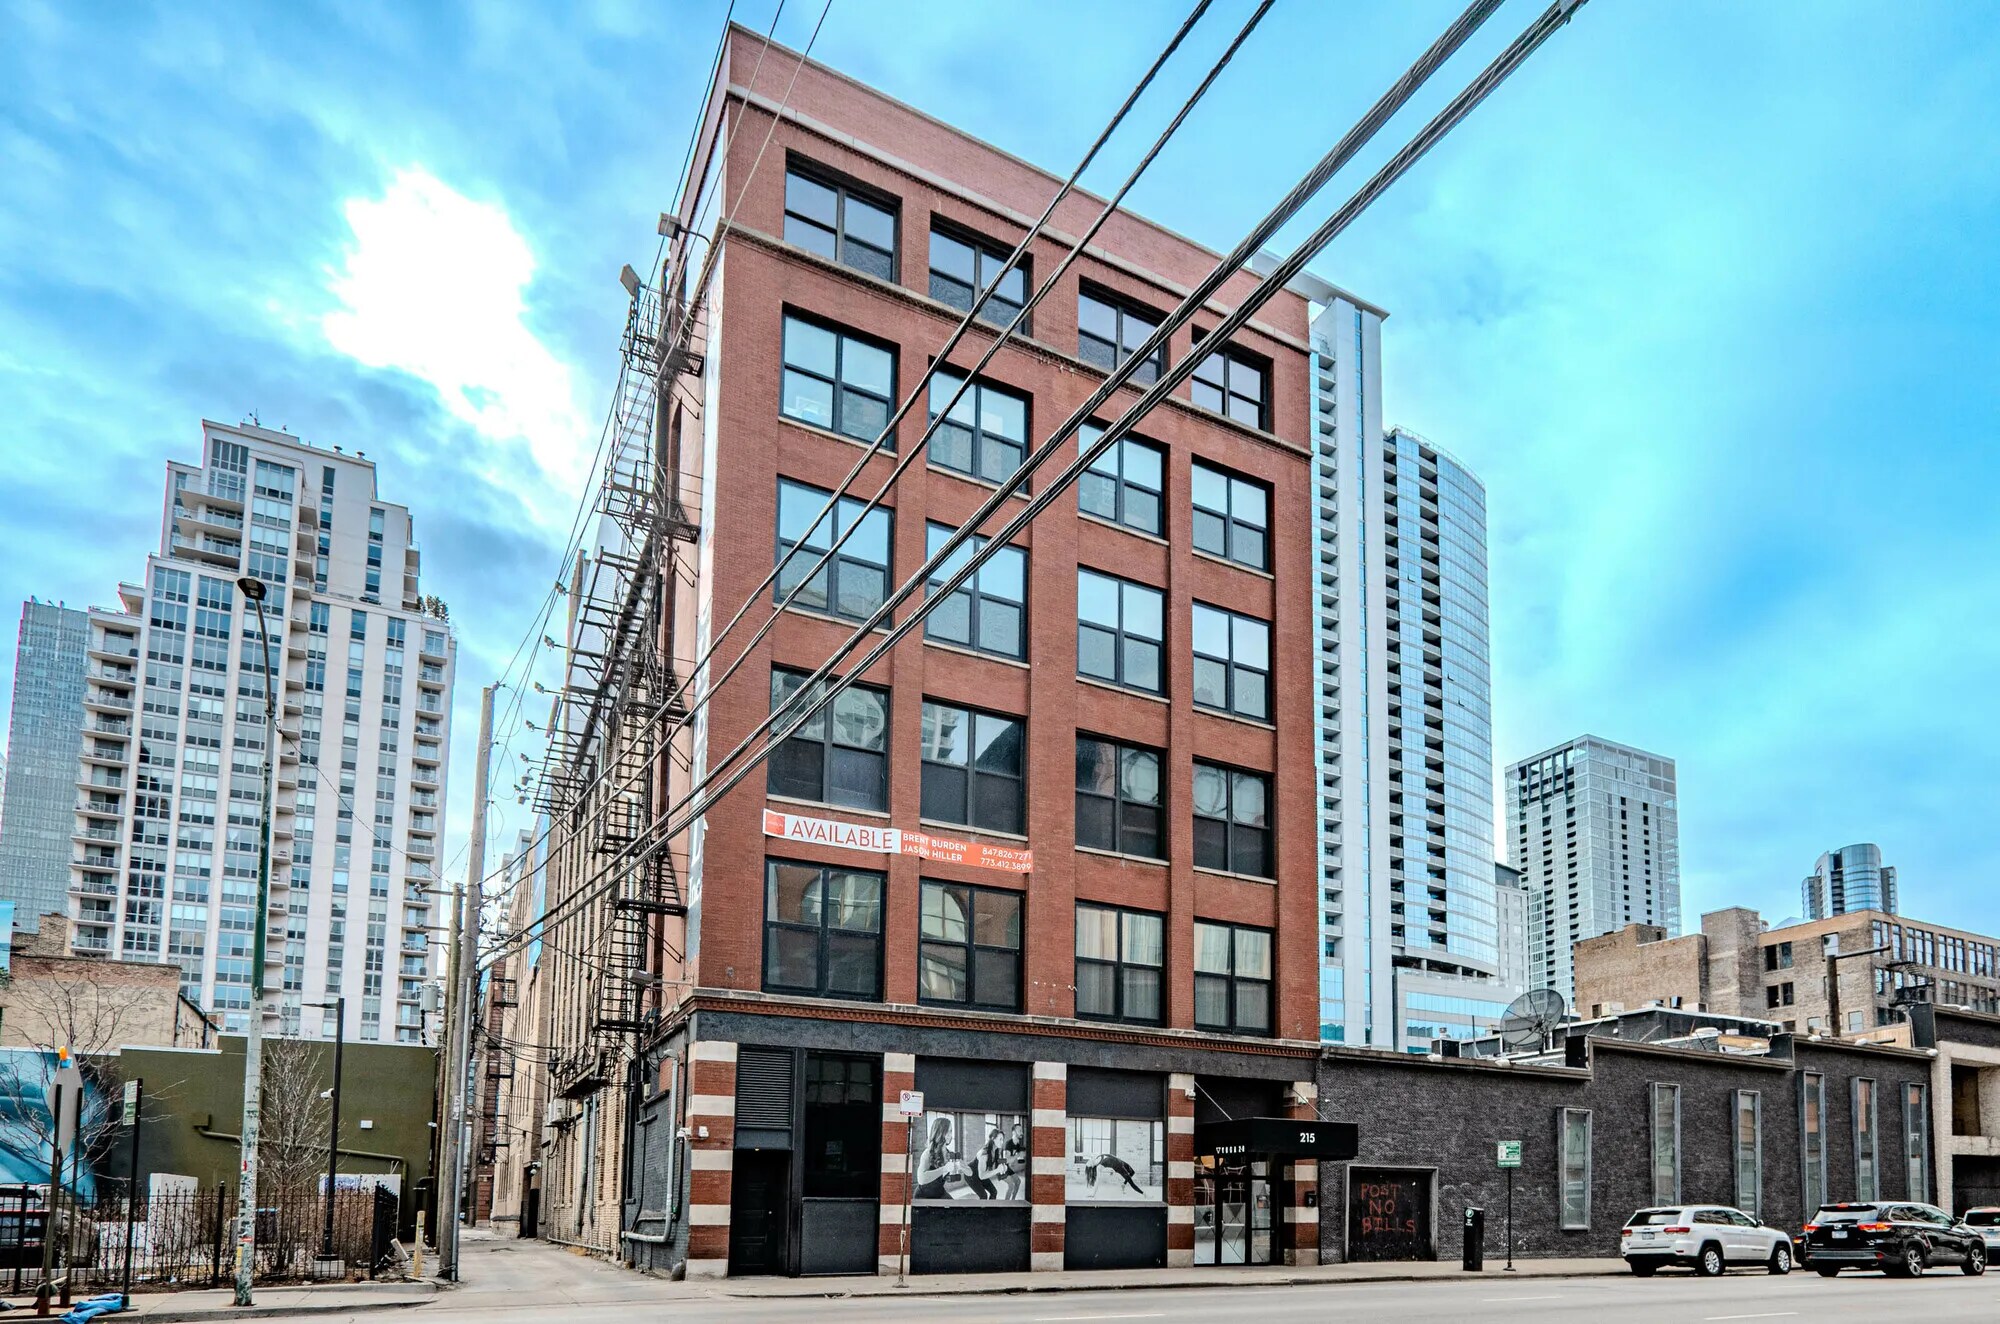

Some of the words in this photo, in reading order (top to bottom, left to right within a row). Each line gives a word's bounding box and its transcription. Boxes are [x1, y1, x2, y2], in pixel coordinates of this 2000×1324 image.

[791, 819, 893, 849] AVAILABLE
[902, 833, 929, 846] BRENT
[931, 839, 967, 852] BURDEN
[902, 845, 930, 857] JASON
[932, 851, 963, 862] HILLER
[1299, 1132, 1316, 1144] 215
[1361, 1183, 1402, 1201] POST
[1369, 1199, 1396, 1215] NO
[1361, 1216, 1417, 1234] BILLS
